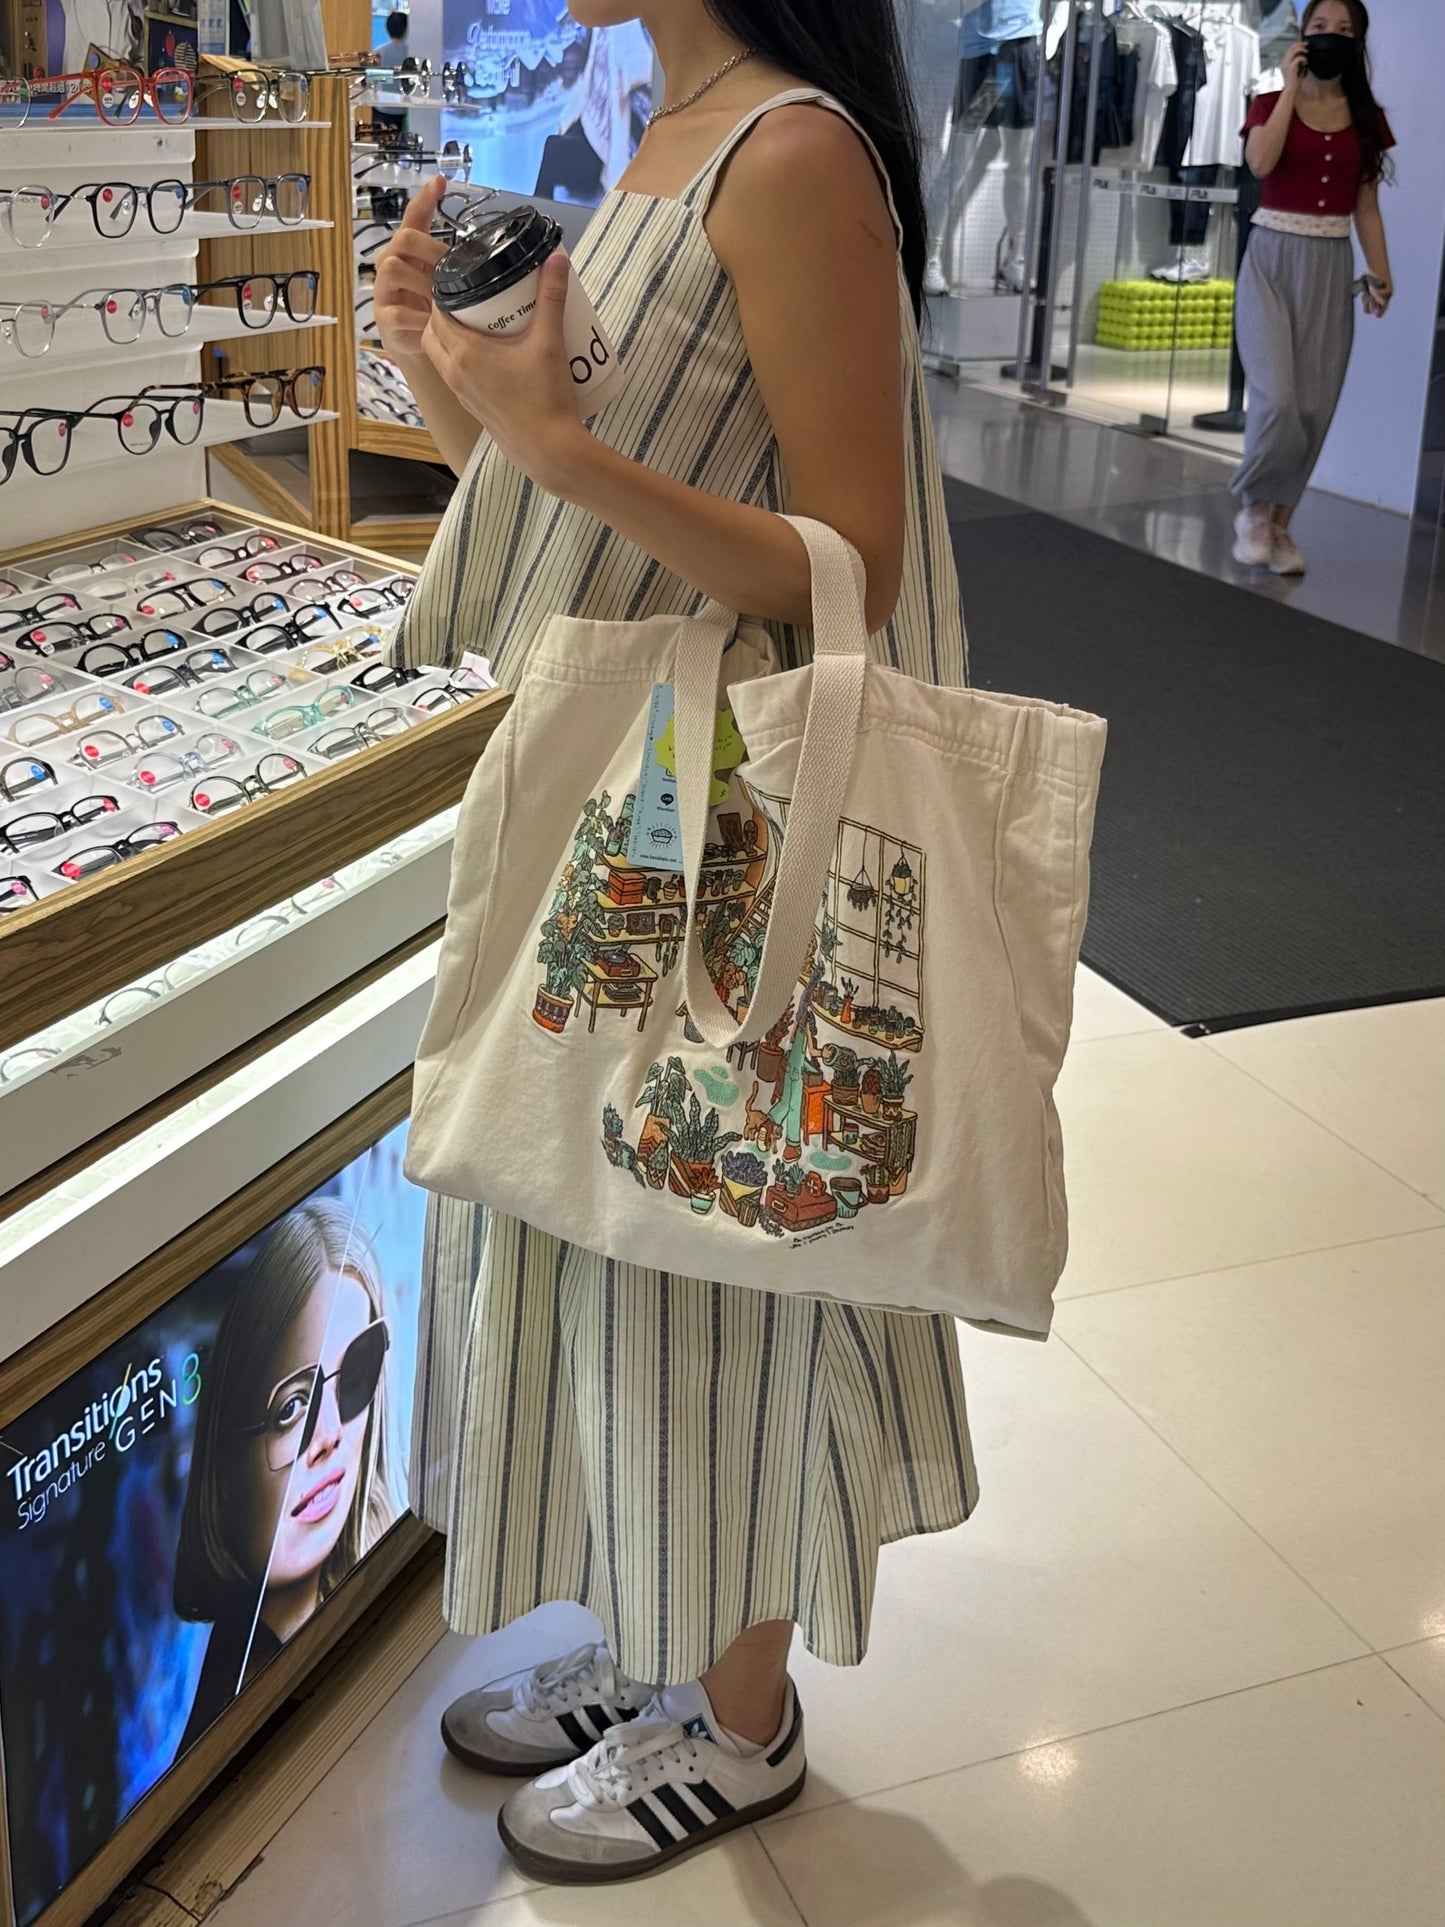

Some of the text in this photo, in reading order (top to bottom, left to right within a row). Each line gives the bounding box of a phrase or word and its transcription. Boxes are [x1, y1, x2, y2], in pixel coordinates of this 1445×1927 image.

[487, 313, 516, 331] Coffee
[6, 1358, 163, 1500] Transitions
[17, 1441, 106, 1530] Signature
